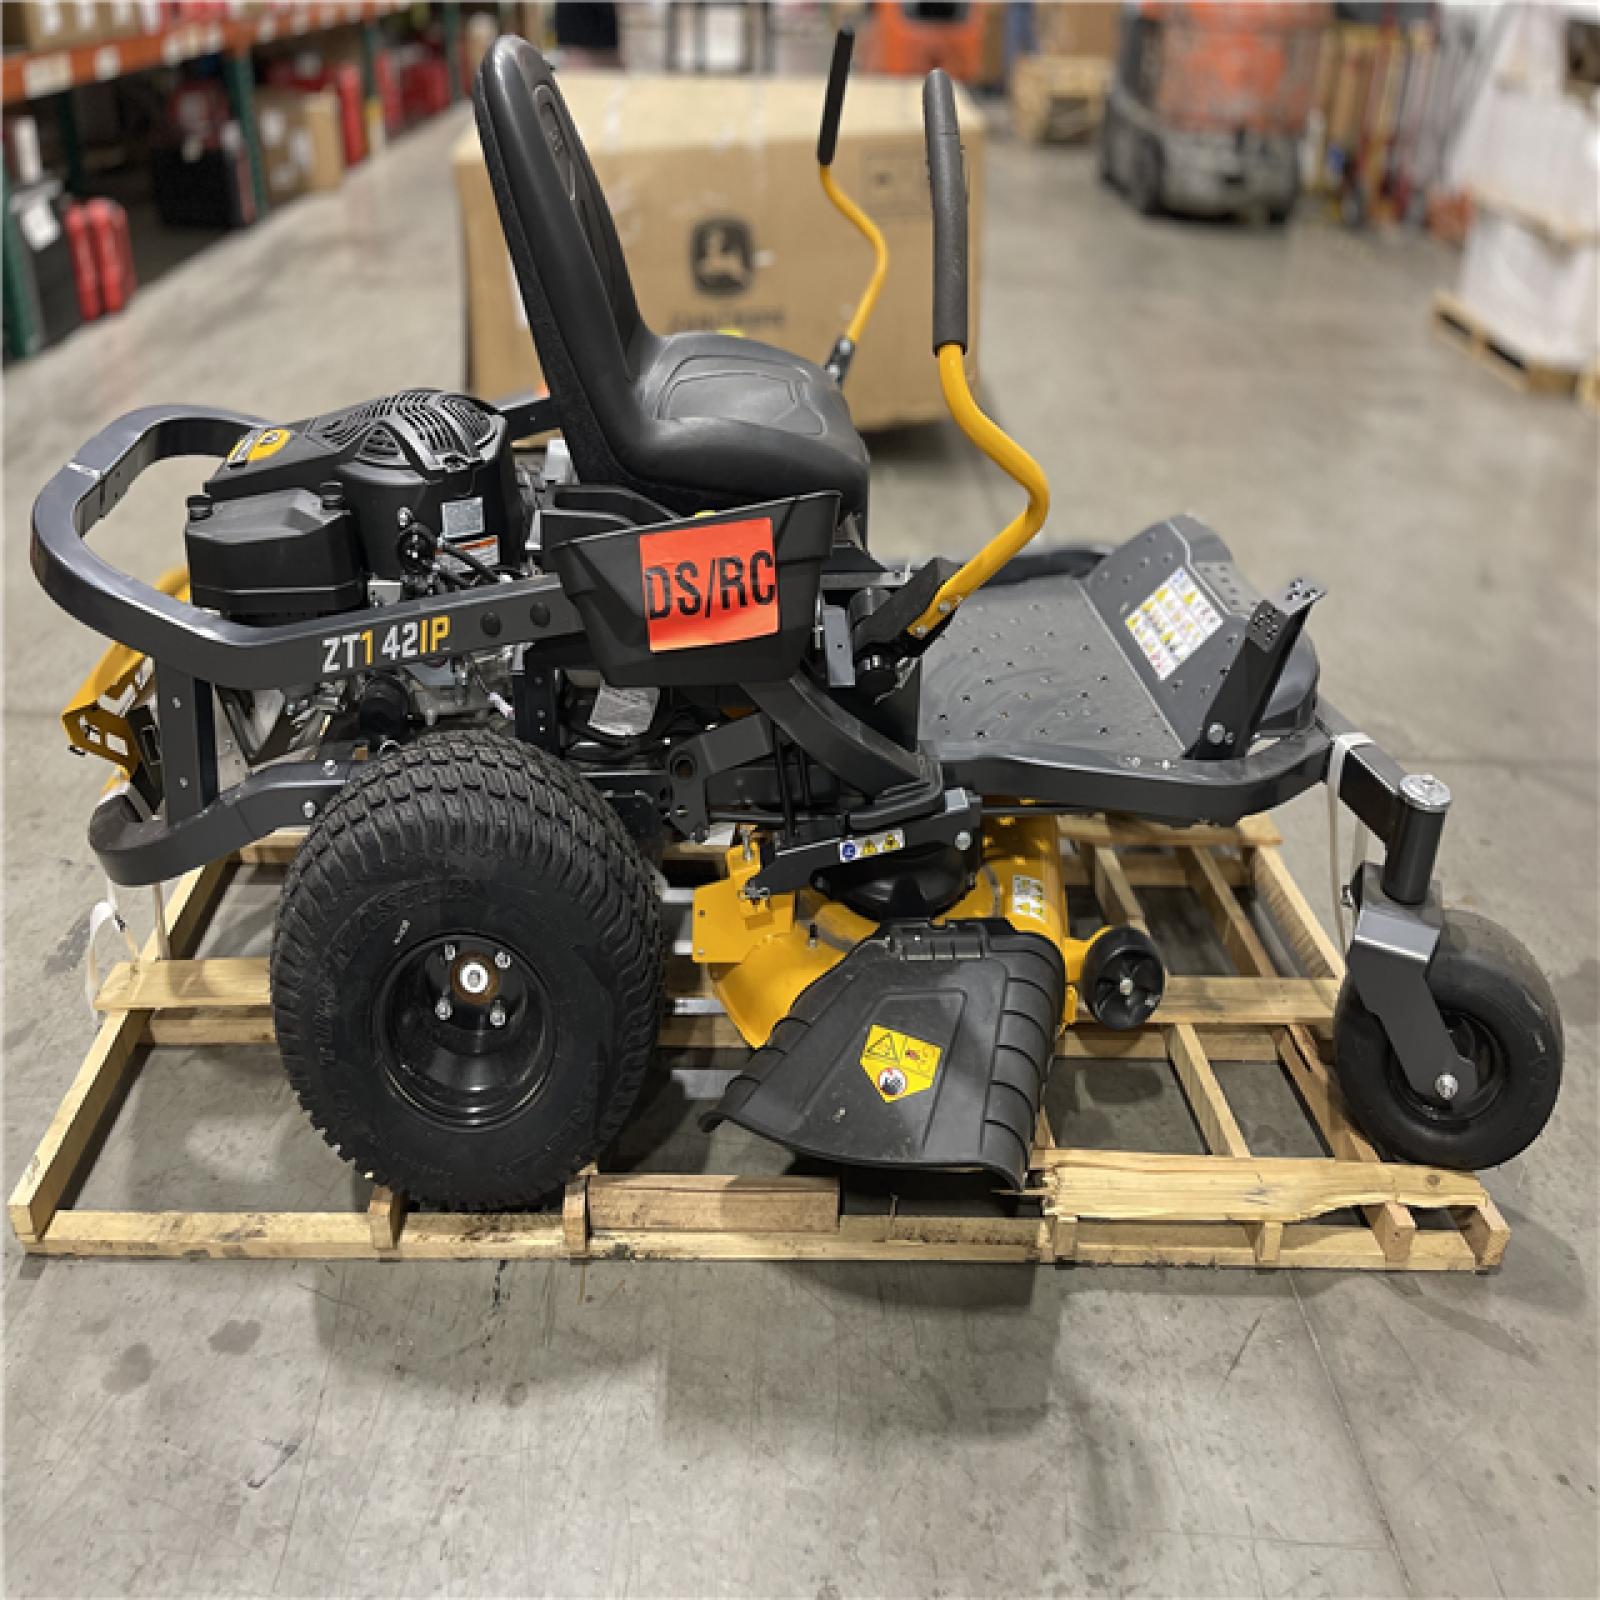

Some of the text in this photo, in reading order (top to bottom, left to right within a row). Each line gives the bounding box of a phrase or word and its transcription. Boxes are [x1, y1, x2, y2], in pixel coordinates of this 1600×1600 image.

[645, 550, 776, 619] DS/RC
[322, 615, 450, 673] ZT1 42IP
